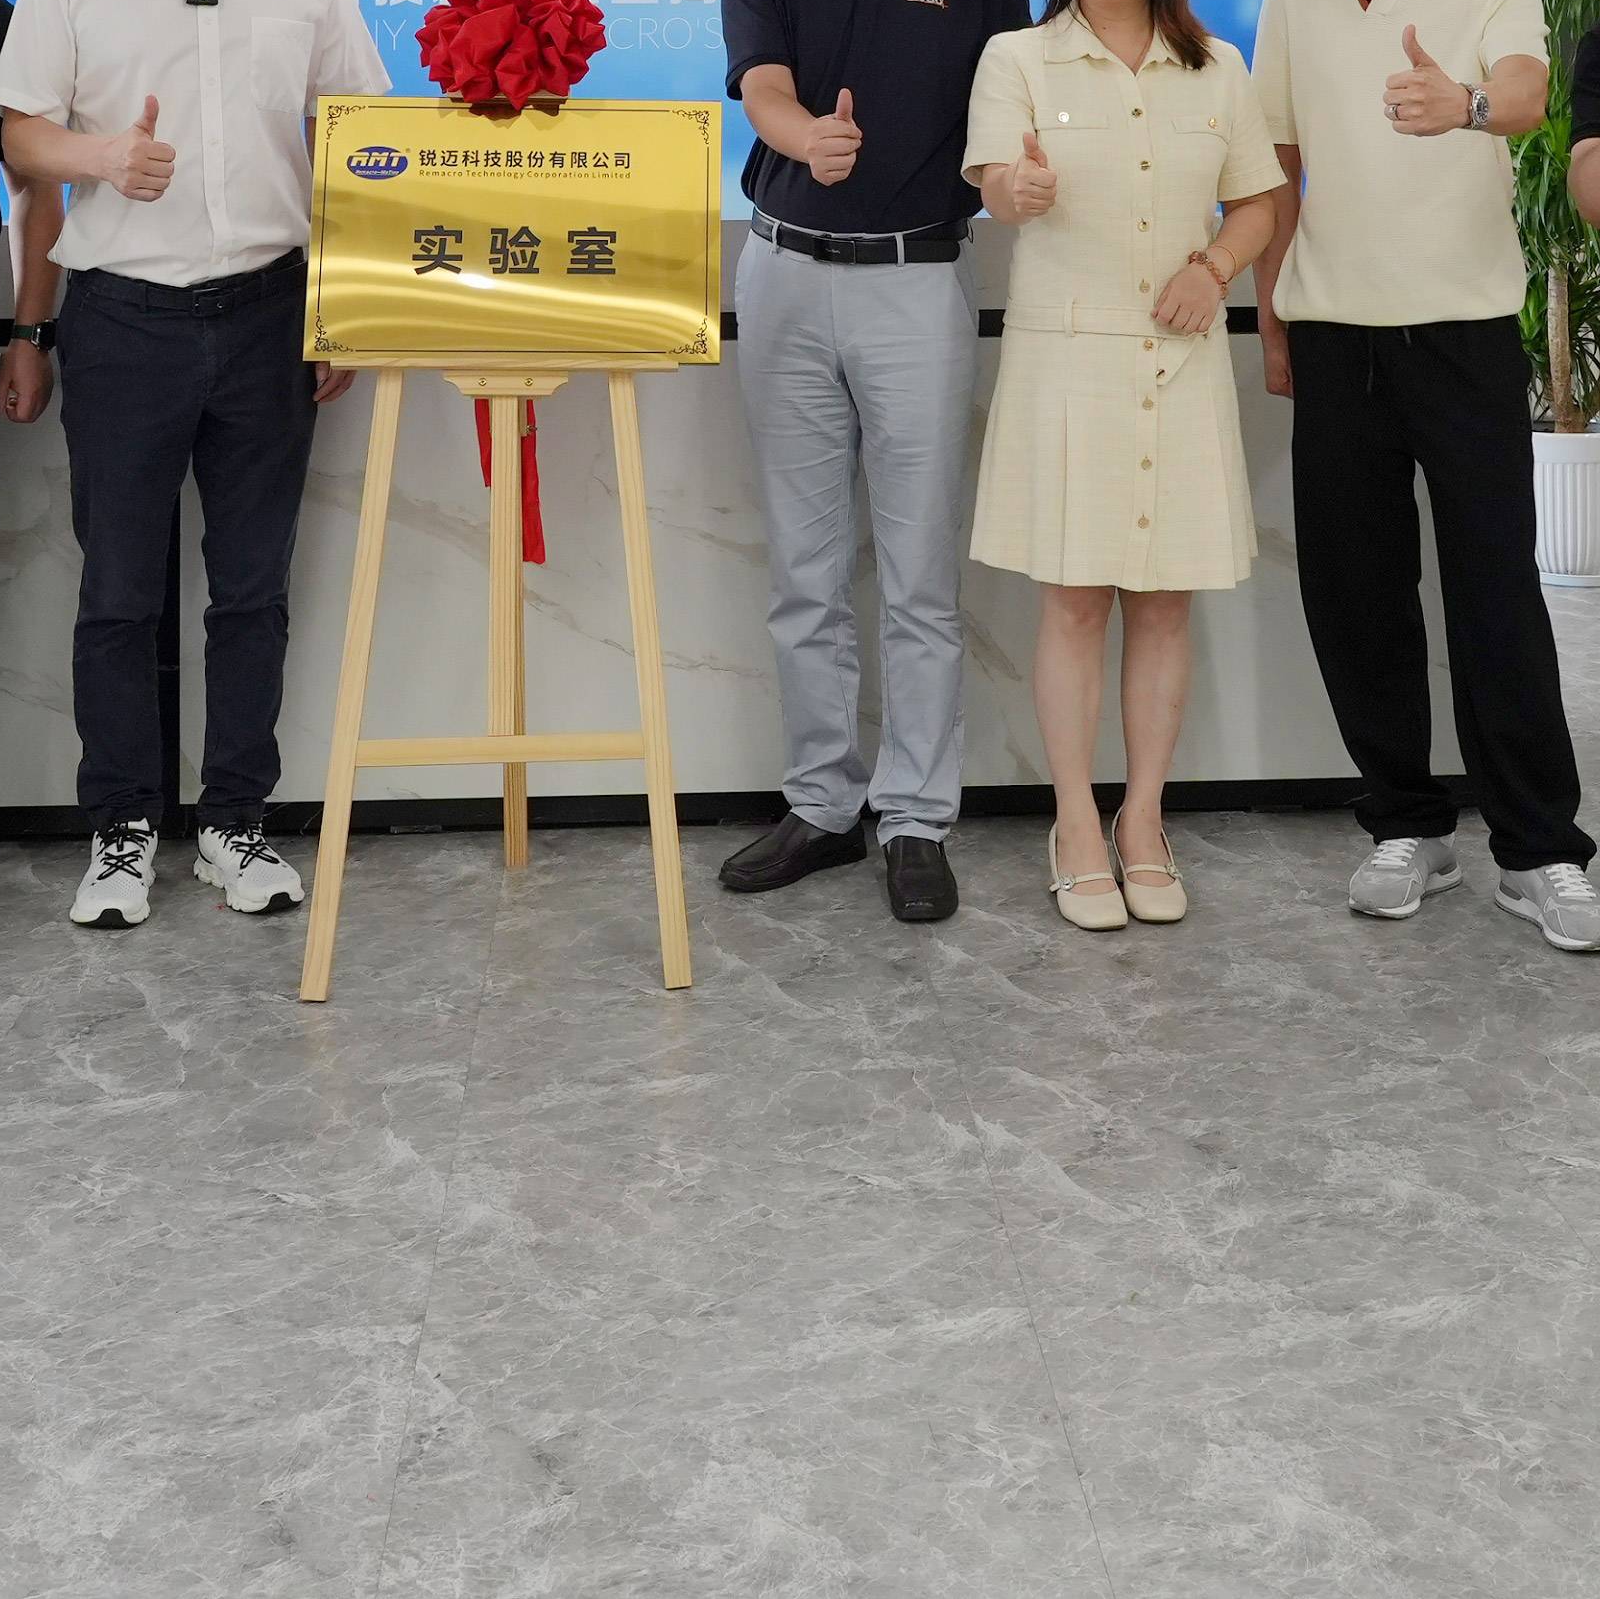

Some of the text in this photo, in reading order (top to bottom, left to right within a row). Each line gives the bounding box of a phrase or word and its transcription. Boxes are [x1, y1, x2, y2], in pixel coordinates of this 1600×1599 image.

[349, 151, 403, 168] RMT
[418, 148, 631, 170] 锐迈科技股份有限公司
[419, 169, 631, 180] Remacro Technology Corporation Limited
[411, 224, 617, 275] 实验室
